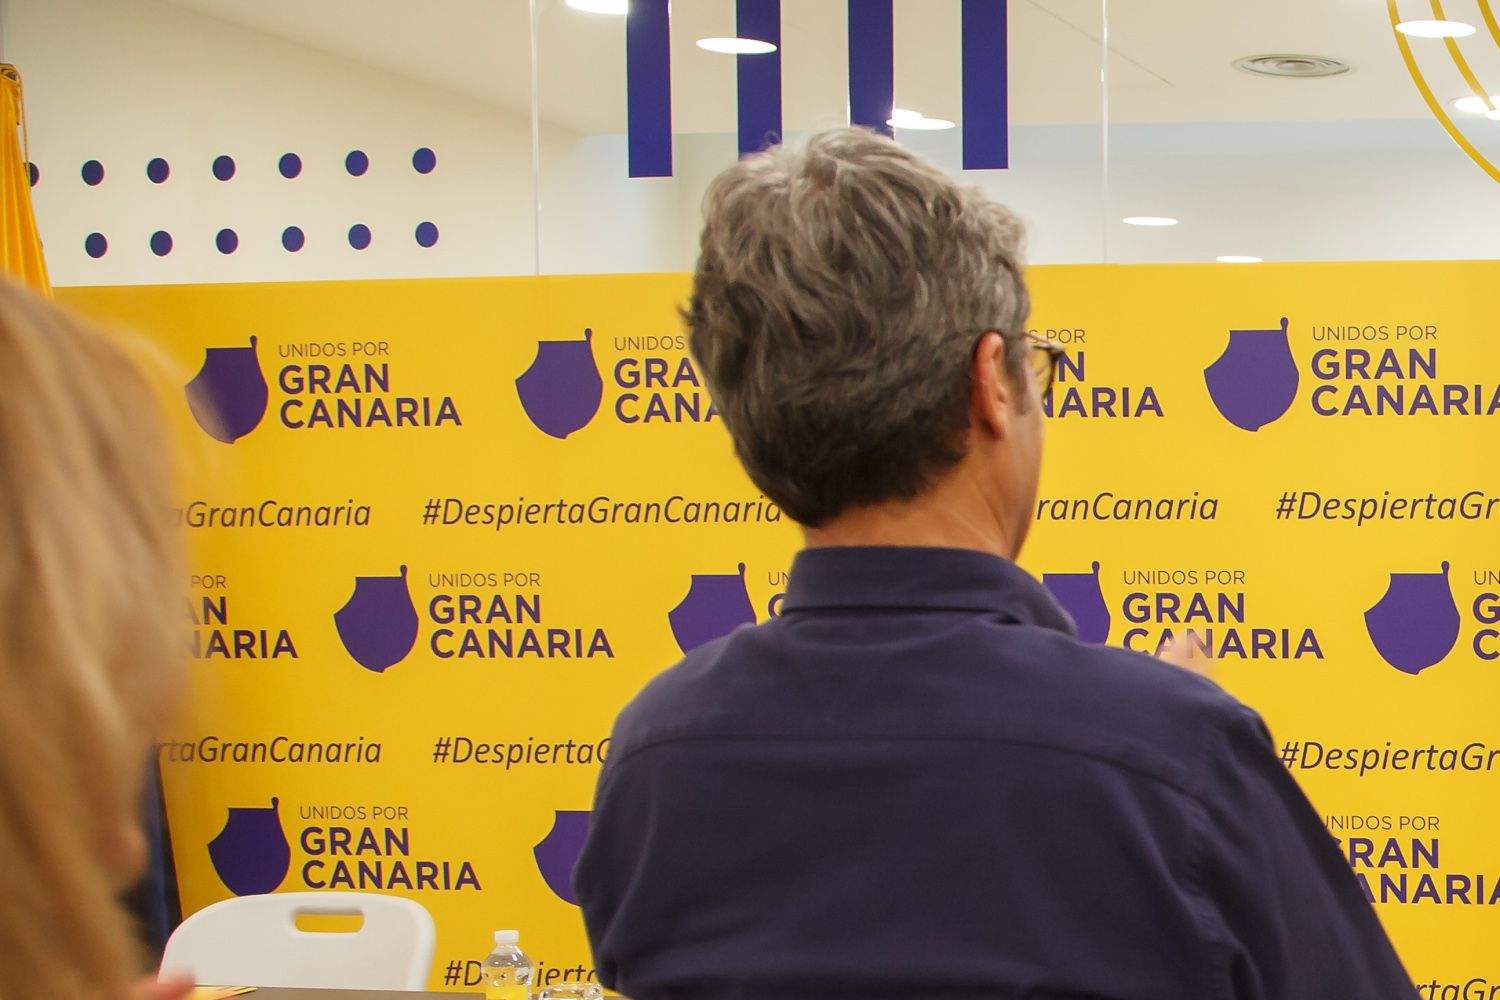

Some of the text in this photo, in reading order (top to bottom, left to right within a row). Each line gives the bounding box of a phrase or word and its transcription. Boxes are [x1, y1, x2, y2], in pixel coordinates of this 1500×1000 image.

[614, 336, 686, 351] UNIDOS
[1045, 329, 1086, 344] POR
[1312, 325, 1437, 341] UNIDOS POR
[278, 342, 390, 358] UNIDOS POR
[1311, 348, 1437, 381] GRAN
[278, 363, 389, 395] GRAN
[614, 357, 701, 389] GRA
[279, 396, 462, 430] CANARIA
[423, 495, 782, 531] #DespiertaGranCanaria
[1036, 492, 1219, 521] ranCanaria
[191, 575, 227, 589] POR
[429, 573, 540, 588] UNIDOS POR
[1123, 571, 1246, 585] UNIDOS POR
[428, 595, 541, 624] GRAN
[1122, 592, 1245, 624] GRAN
[430, 628, 614, 659] CANARIA
[300, 806, 409, 821] UNIDOS POR
[1399, 816, 1440, 831] POR
[299, 826, 410, 857] GRAN
[1346, 837, 1439, 869] RAN
[301, 860, 482, 891] CANARIA
